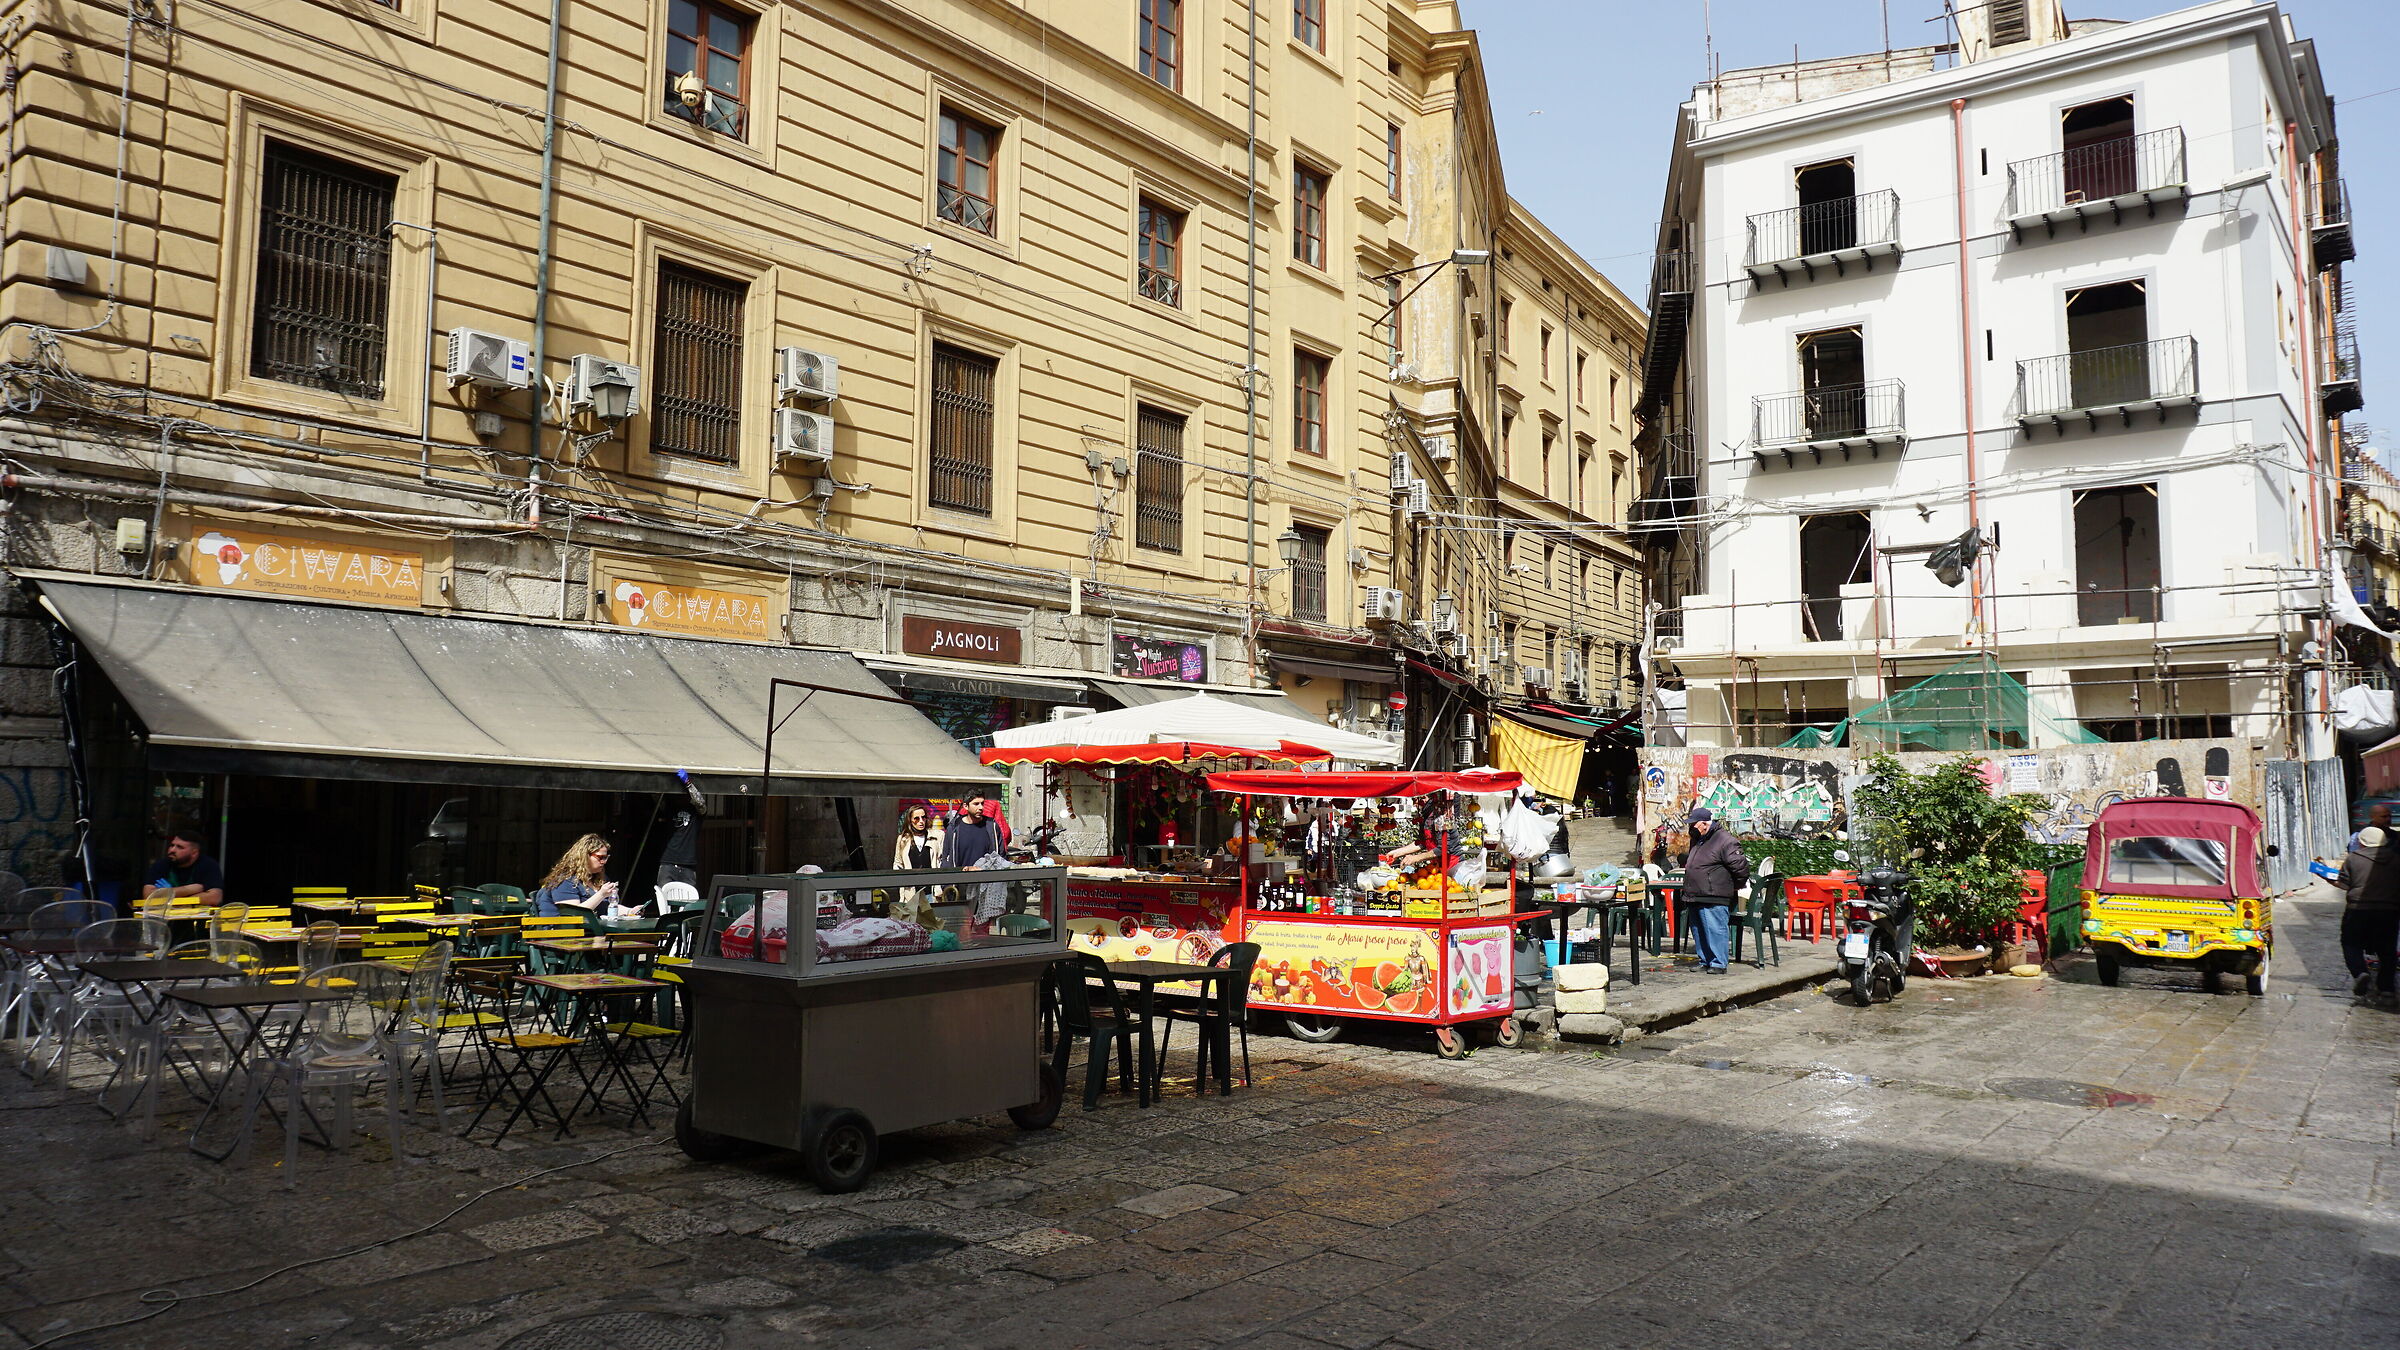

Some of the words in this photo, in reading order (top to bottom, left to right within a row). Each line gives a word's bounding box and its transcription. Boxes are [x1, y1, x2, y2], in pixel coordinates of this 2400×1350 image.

[254, 543, 418, 591] CIWARA
[653, 590, 766, 629] CIWARA
[1325, 932, 1335, 942] da
[1338, 932, 1363, 946] Mario
[1364, 935, 1385, 949] fresco
[1386, 936, 1407, 950] fresco
